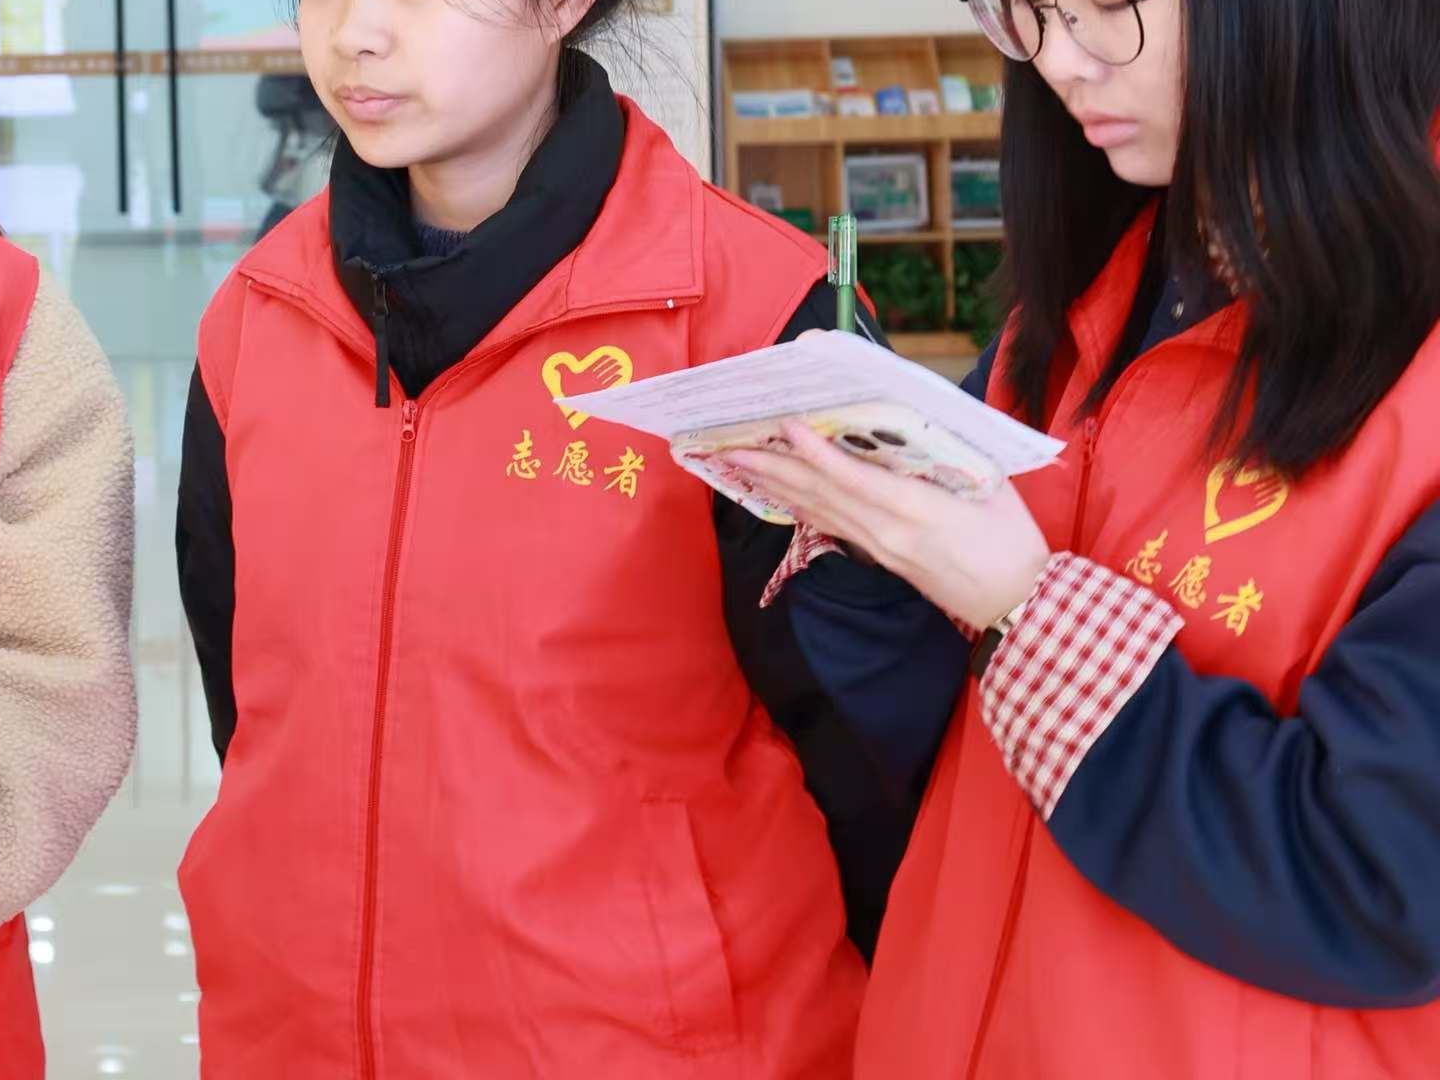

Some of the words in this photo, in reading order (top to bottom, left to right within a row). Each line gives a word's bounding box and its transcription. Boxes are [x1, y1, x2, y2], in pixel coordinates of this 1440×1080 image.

[506, 429, 645, 499] 志愿者
[1124, 529, 1264, 636] 志愿者
